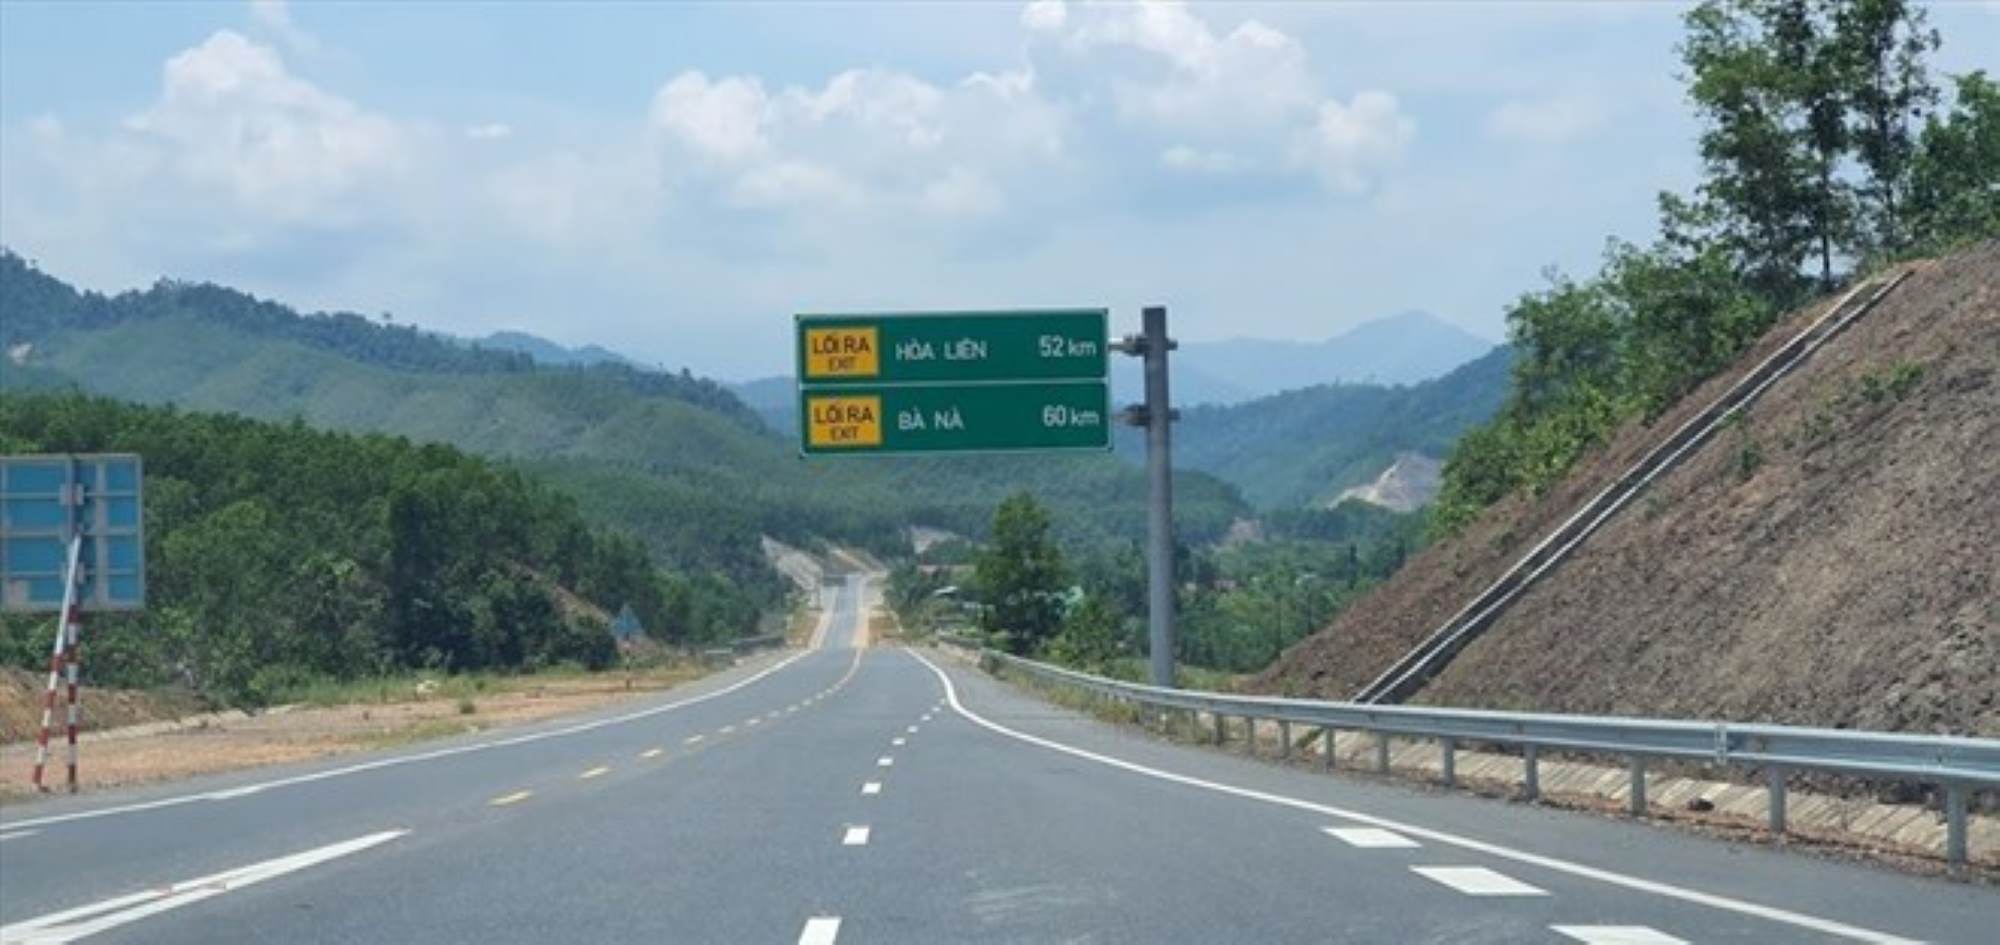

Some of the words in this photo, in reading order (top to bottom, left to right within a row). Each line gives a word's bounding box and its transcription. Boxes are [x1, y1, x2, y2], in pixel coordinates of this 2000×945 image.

[843, 336, 870, 354] RA
[896, 339, 934, 361] HÒA
[944, 337, 988, 360] LIÊN
[1039, 335, 1064, 357] 52
[1068, 337, 1097, 357] km
[828, 356, 856, 371] EXIT
[846, 405, 873, 423] RA
[898, 405, 926, 430] BÀ
[934, 405, 965, 430] NÀ
[1043, 404, 1067, 426] 60
[1070, 406, 1100, 425] km
[830, 425, 858, 441] EXIT
